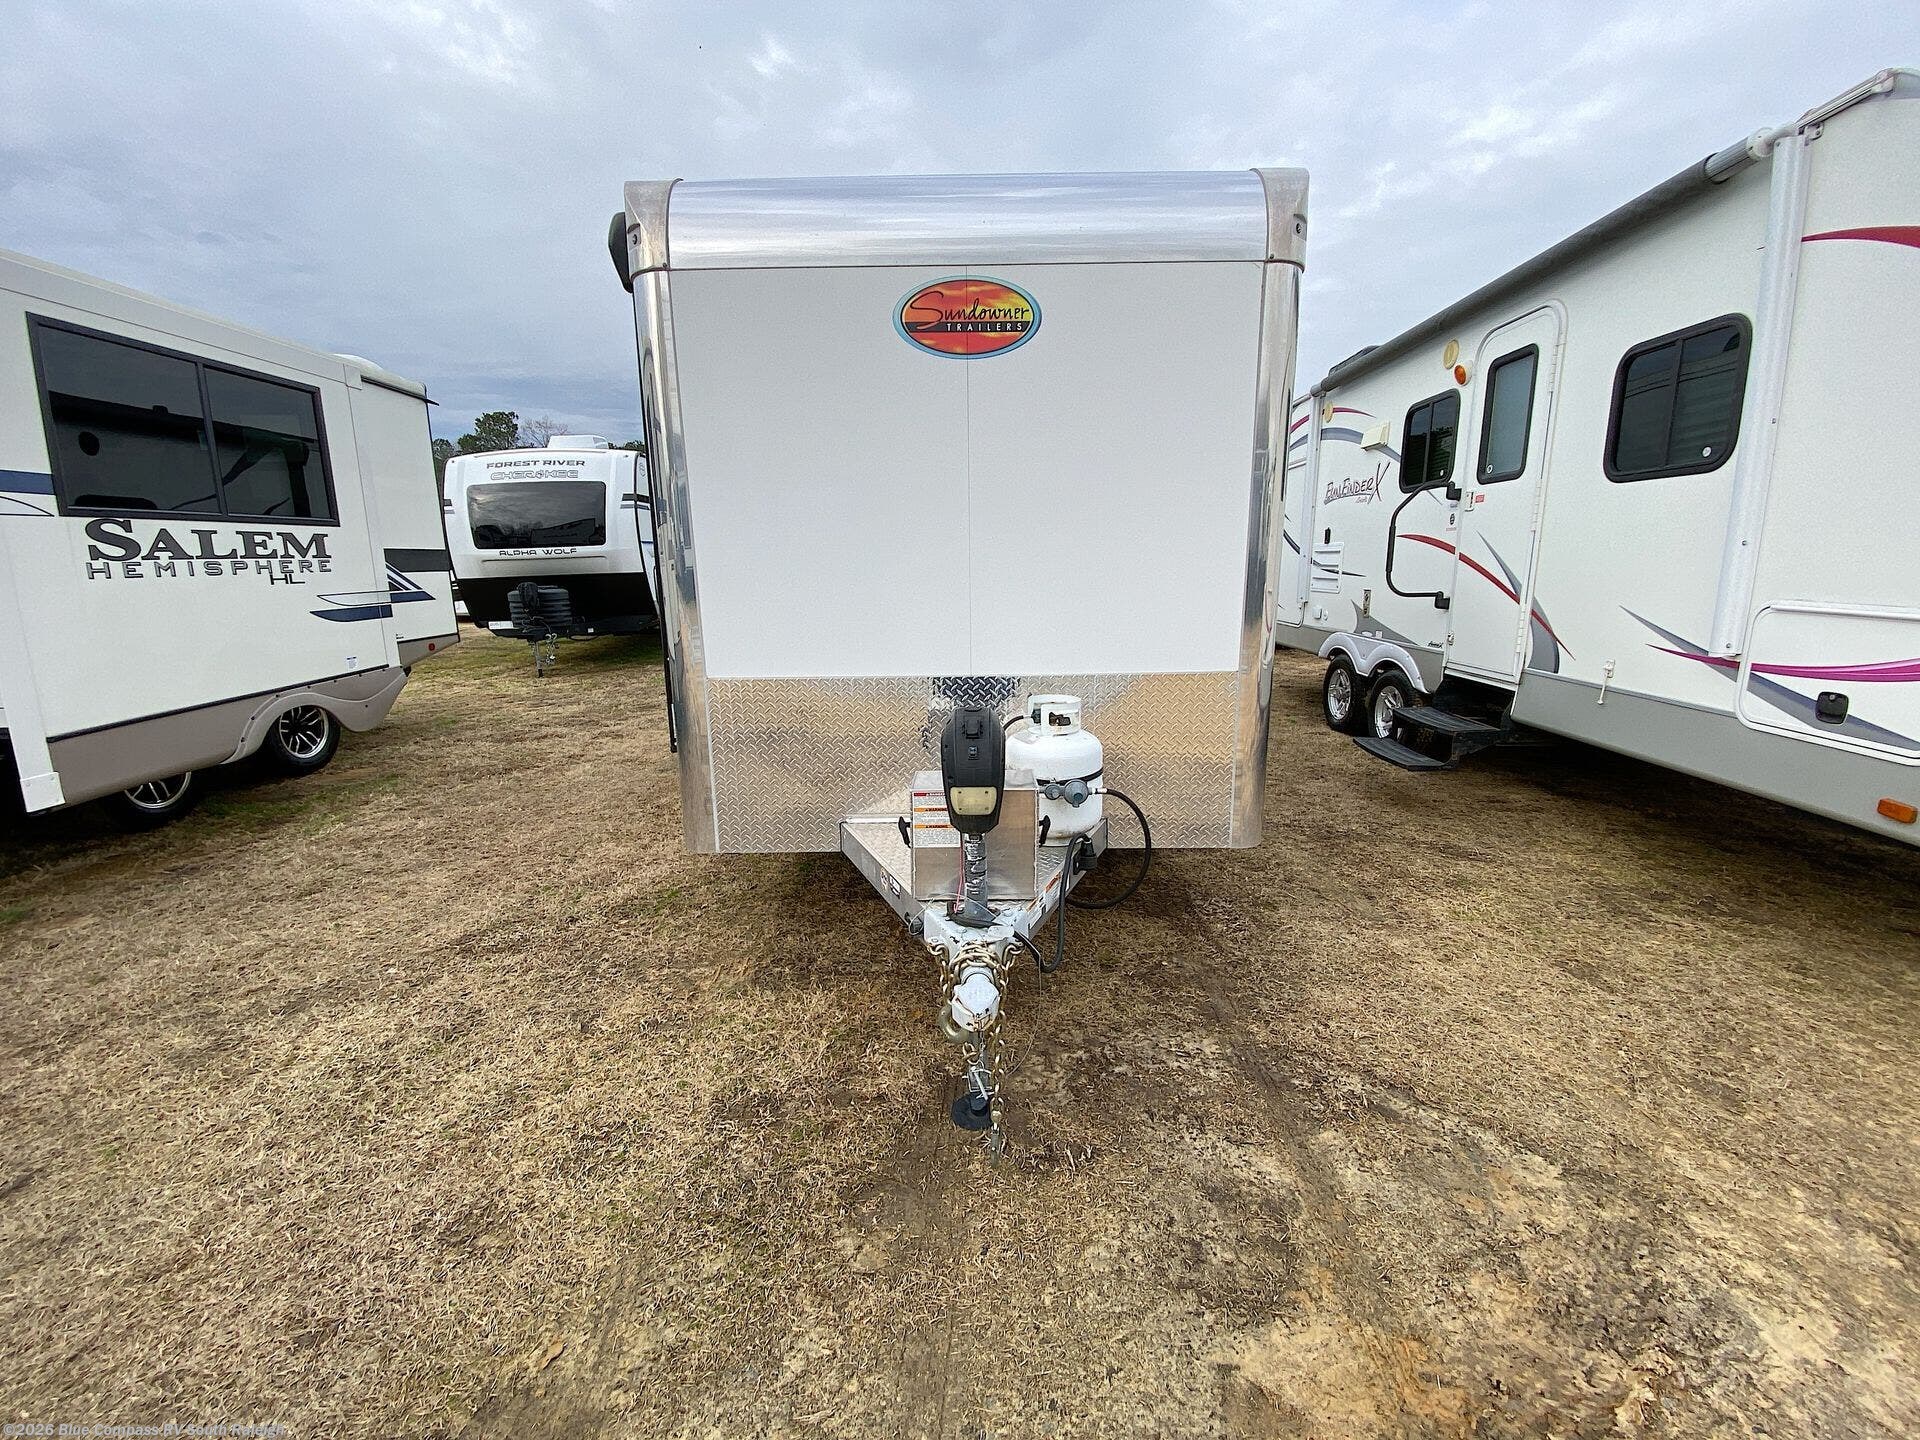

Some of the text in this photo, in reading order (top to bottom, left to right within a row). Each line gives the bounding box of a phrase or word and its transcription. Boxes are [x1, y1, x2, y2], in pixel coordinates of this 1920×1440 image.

[909, 290, 1030, 330] Sundowner
[946, 322, 1023, 331] TRAILERS
[486, 459, 586, 469] FOREST RIVER
[490, 469, 579, 481] CHEROKEE
[84, 518, 332, 561] SALEM
[499, 547, 577, 557] ALPHA WOLF
[85, 559, 333, 580] HEMISPHERE
[269, 574, 306, 585] HL
